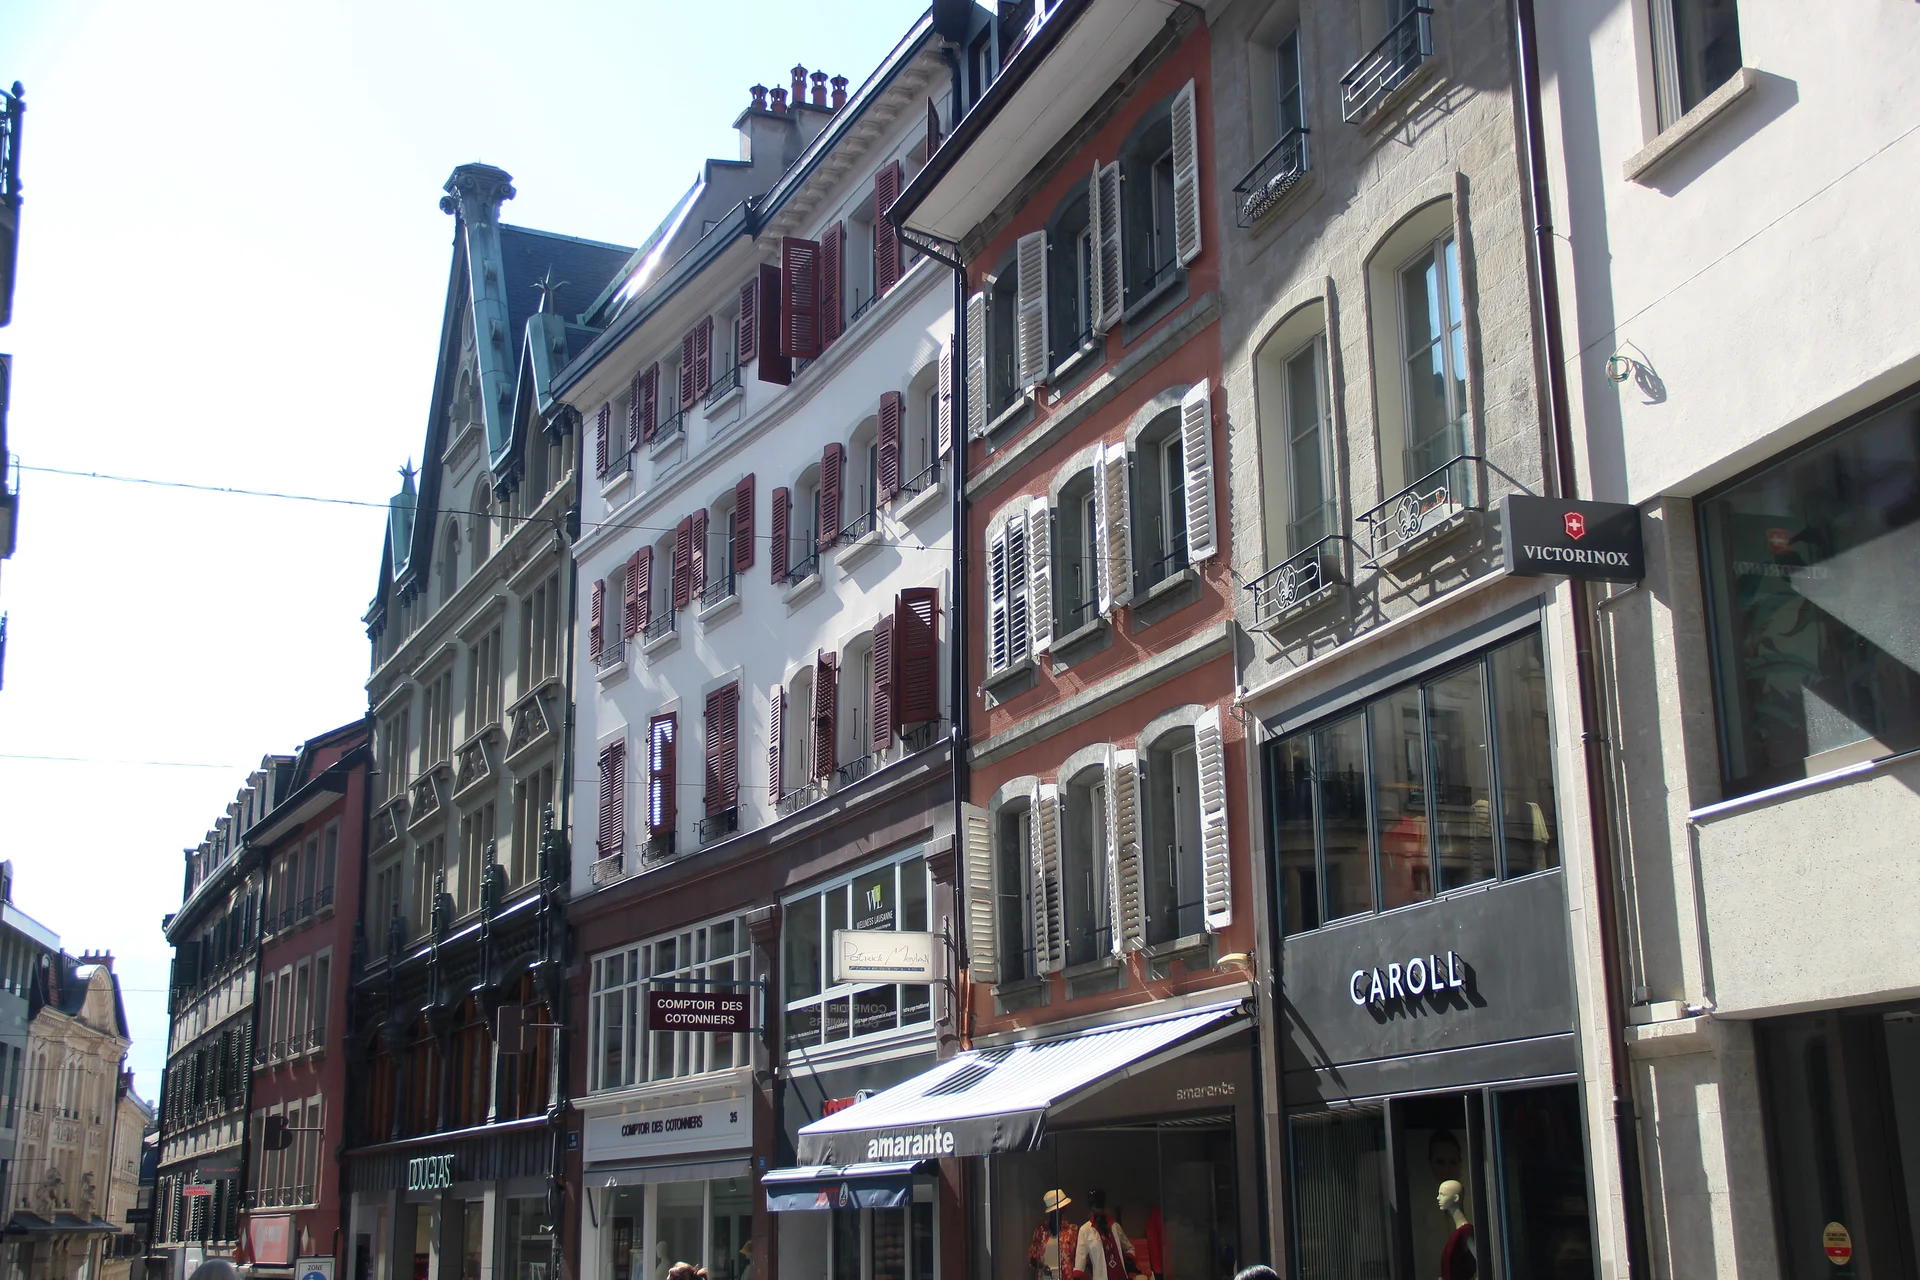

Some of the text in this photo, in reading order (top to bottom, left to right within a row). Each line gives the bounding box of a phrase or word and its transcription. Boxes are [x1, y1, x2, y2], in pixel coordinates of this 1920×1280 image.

[1523, 545, 1630, 566] VICTORINOX
[856, 916, 874, 930] WELLNESS
[873, 910, 893, 925] LAUSANNE
[1350, 950, 1462, 1005] CAROLL
[657, 999, 743, 1011] COMPTOIR DES
[665, 1013, 735, 1025] COTONNIERS
[1176, 1081, 1235, 1100] amarante
[621, 1114, 703, 1137] COMPTOIR DES COTONNIERS
[729, 1111, 738, 1124] 35
[867, 1126, 954, 1159] amarante
[408, 1154, 452, 1191] DOUGLAS
